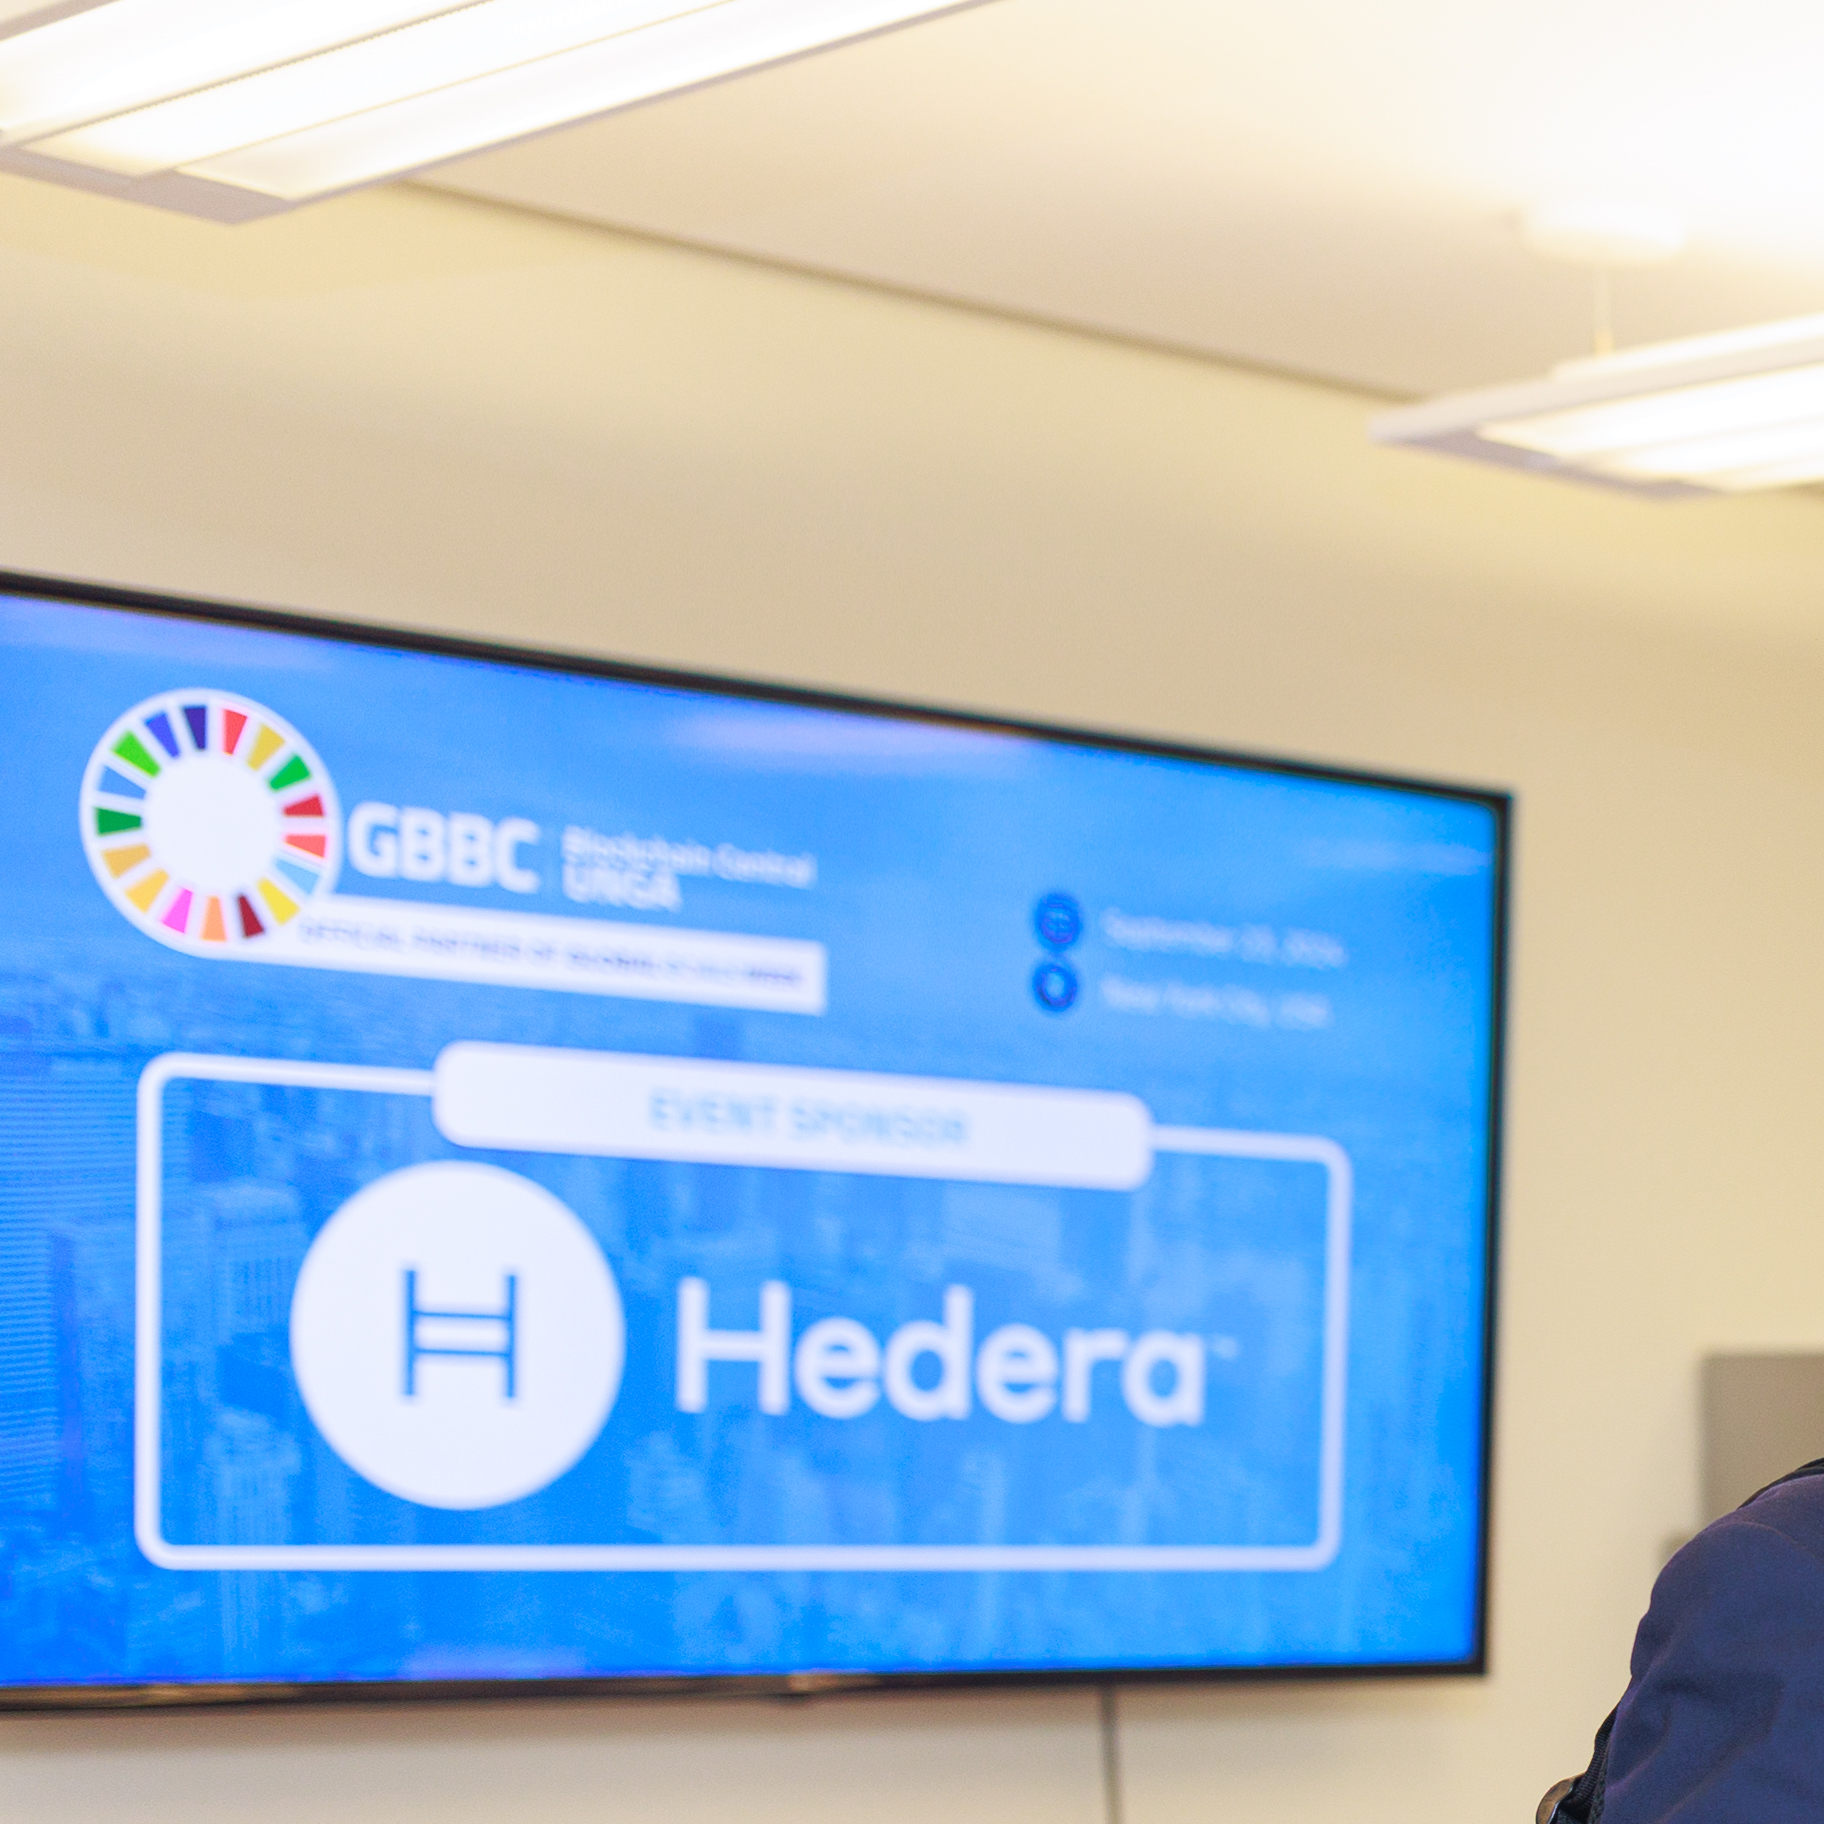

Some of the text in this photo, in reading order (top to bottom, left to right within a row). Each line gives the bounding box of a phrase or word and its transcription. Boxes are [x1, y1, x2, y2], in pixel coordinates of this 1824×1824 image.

[348, 801, 541, 894] GBBC
[649, 1088, 968, 1146] EVENT SPONSOR
[675, 1278, 1206, 1426] Hedera
